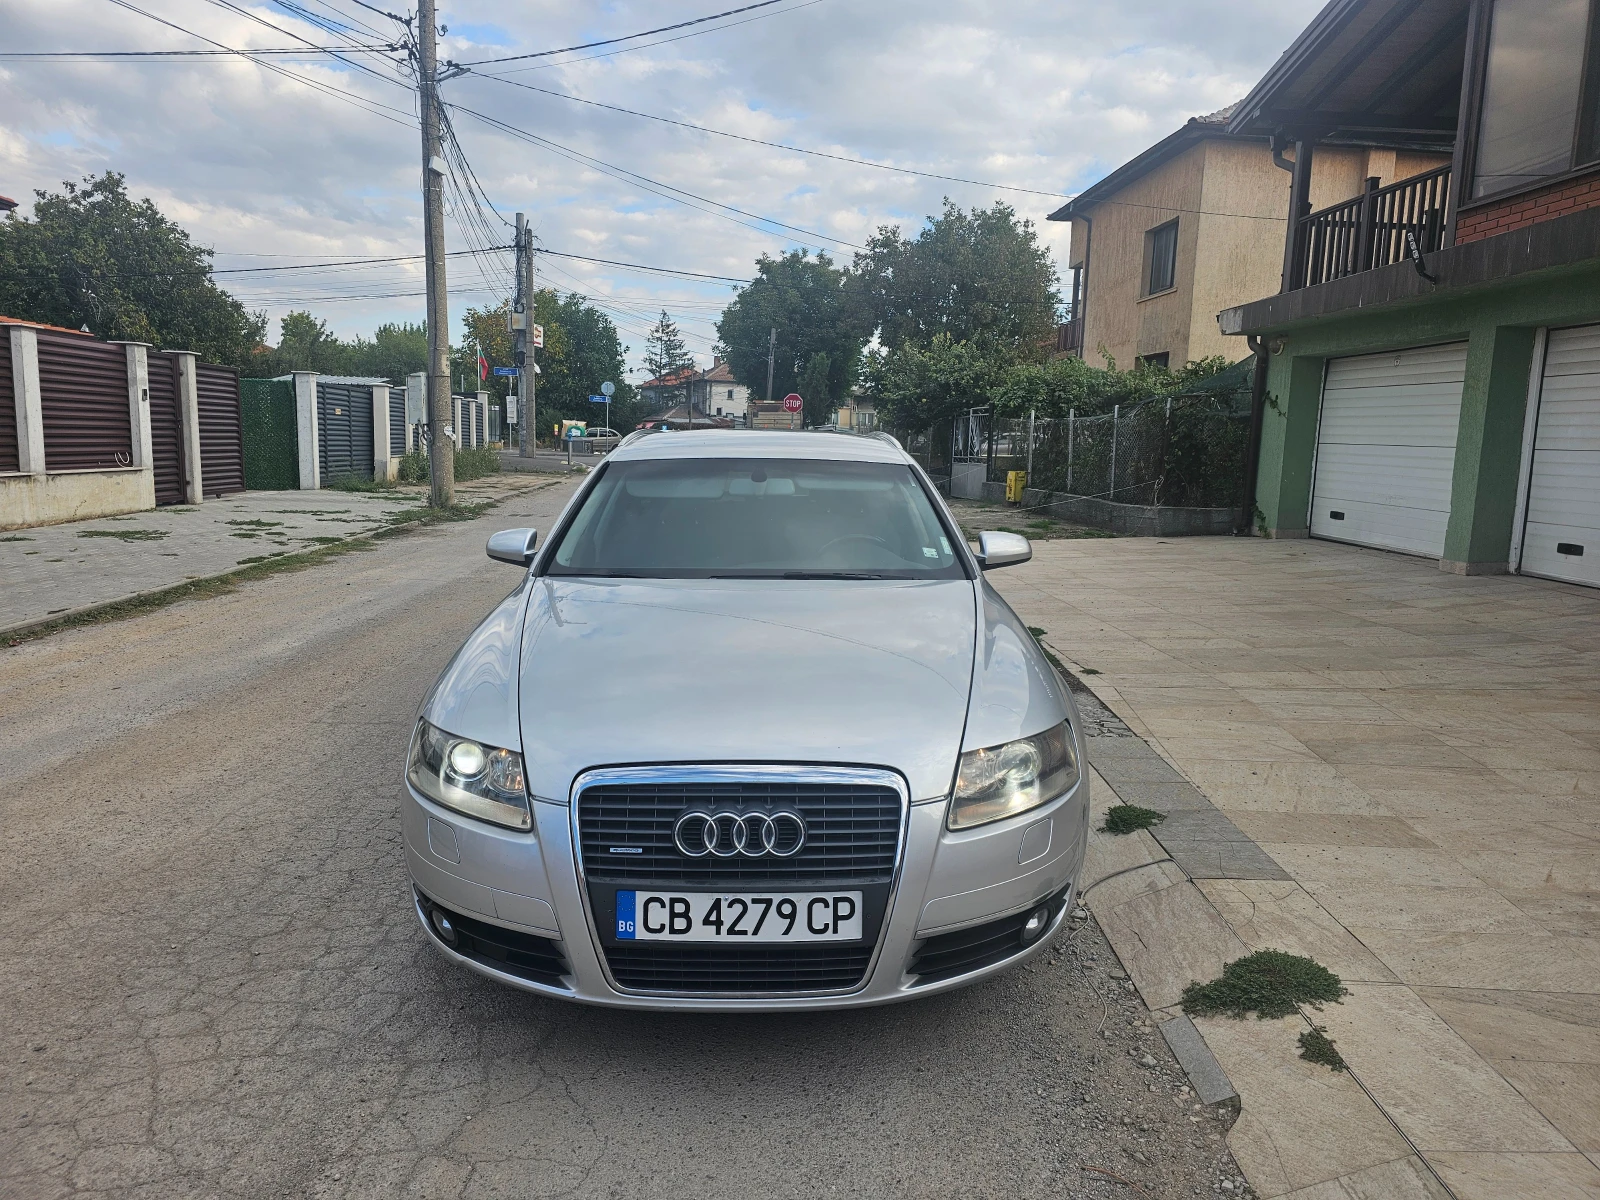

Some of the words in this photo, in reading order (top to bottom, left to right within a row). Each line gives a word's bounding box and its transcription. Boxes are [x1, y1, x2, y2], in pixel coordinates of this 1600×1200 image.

[785, 399, 801, 408] STOP
[642, 896, 693, 935] CB
[702, 897, 798, 936] 4279
[806, 896, 856, 935] CP
[618, 920, 634, 932] BG
